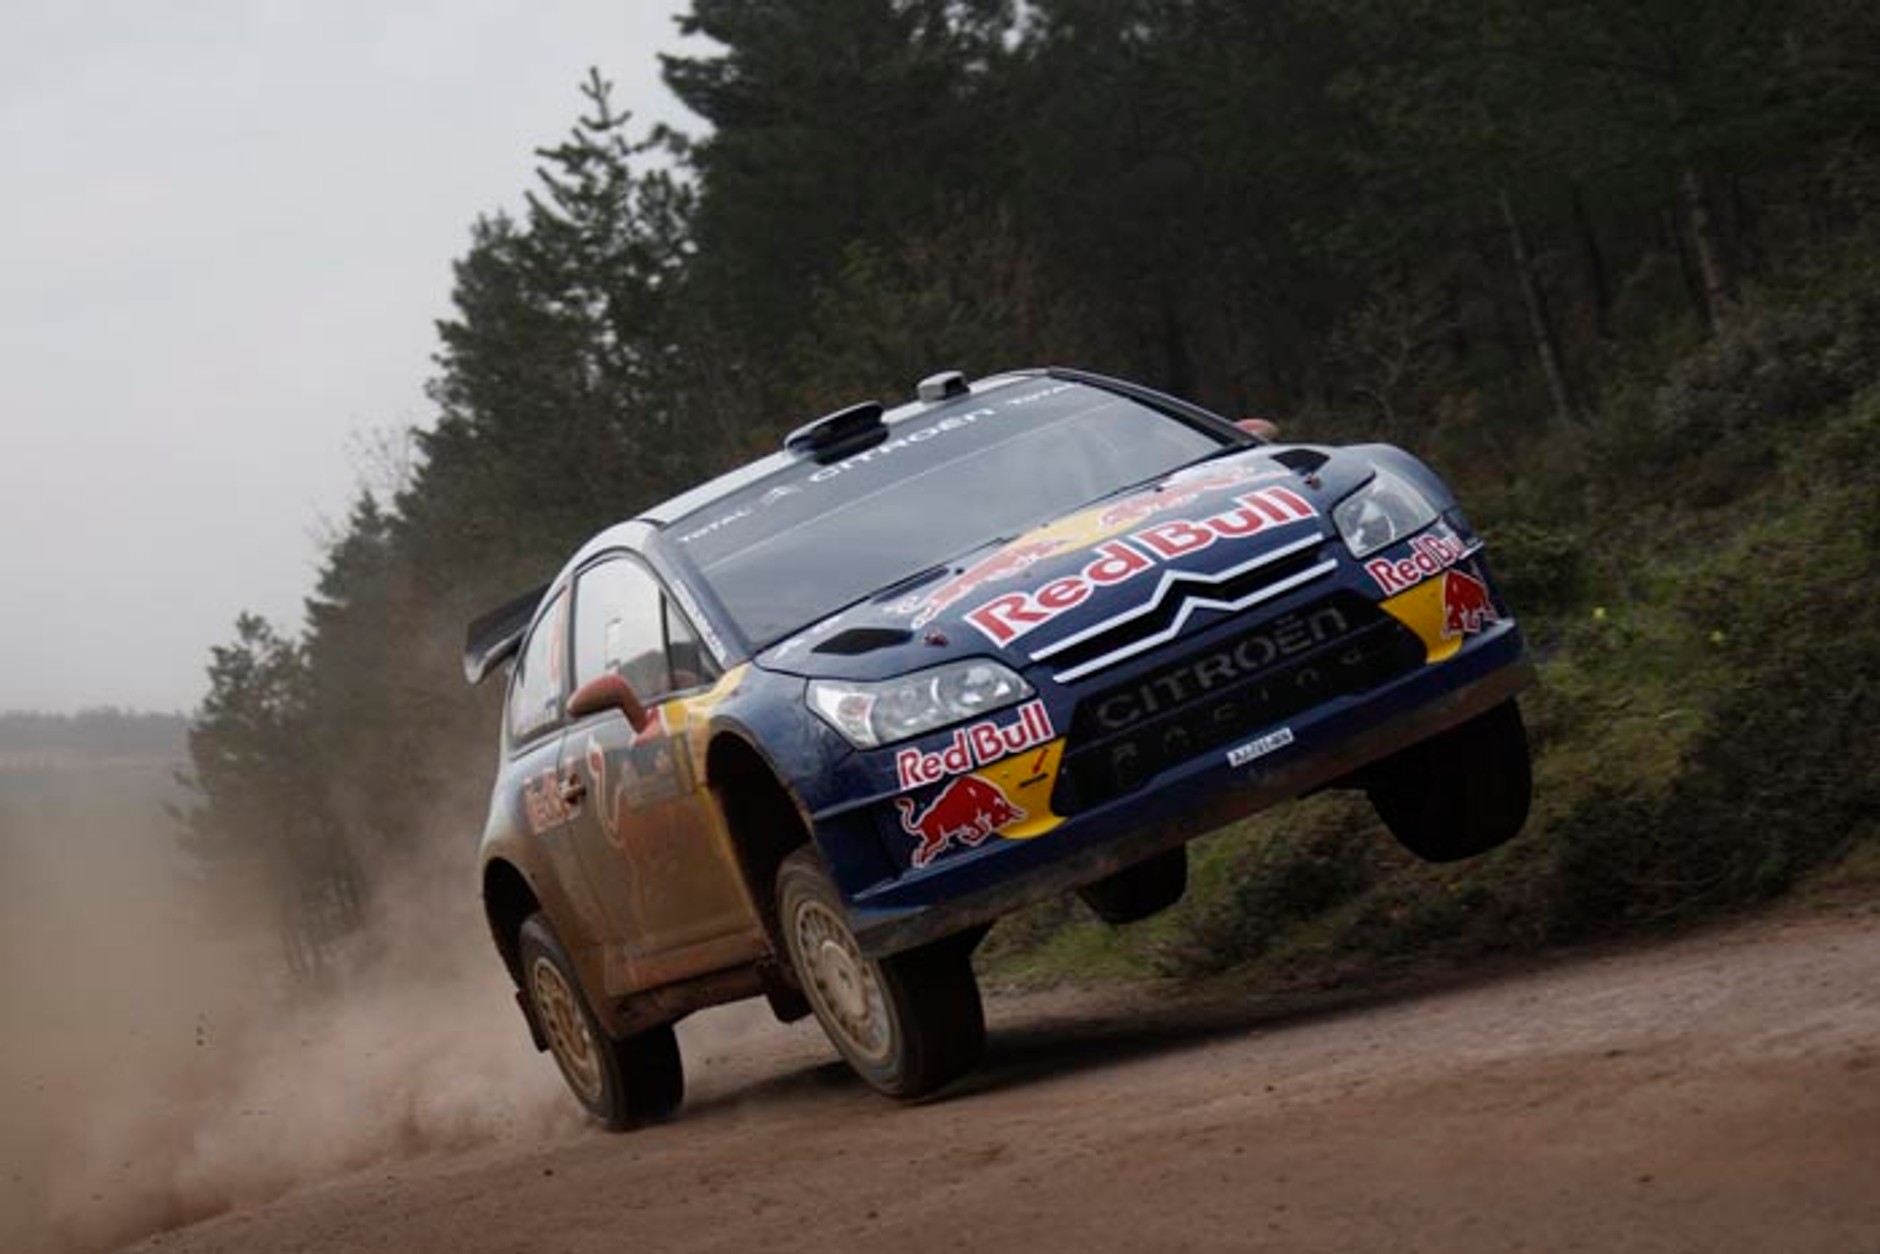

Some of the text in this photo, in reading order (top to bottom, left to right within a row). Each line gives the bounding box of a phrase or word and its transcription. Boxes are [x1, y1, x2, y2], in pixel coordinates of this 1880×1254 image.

[964, 486, 1320, 648] Red Bull
[1364, 538, 1441, 596] Red
[1096, 606, 1349, 729] CITROËN
[897, 699, 1055, 790] Red Bull
